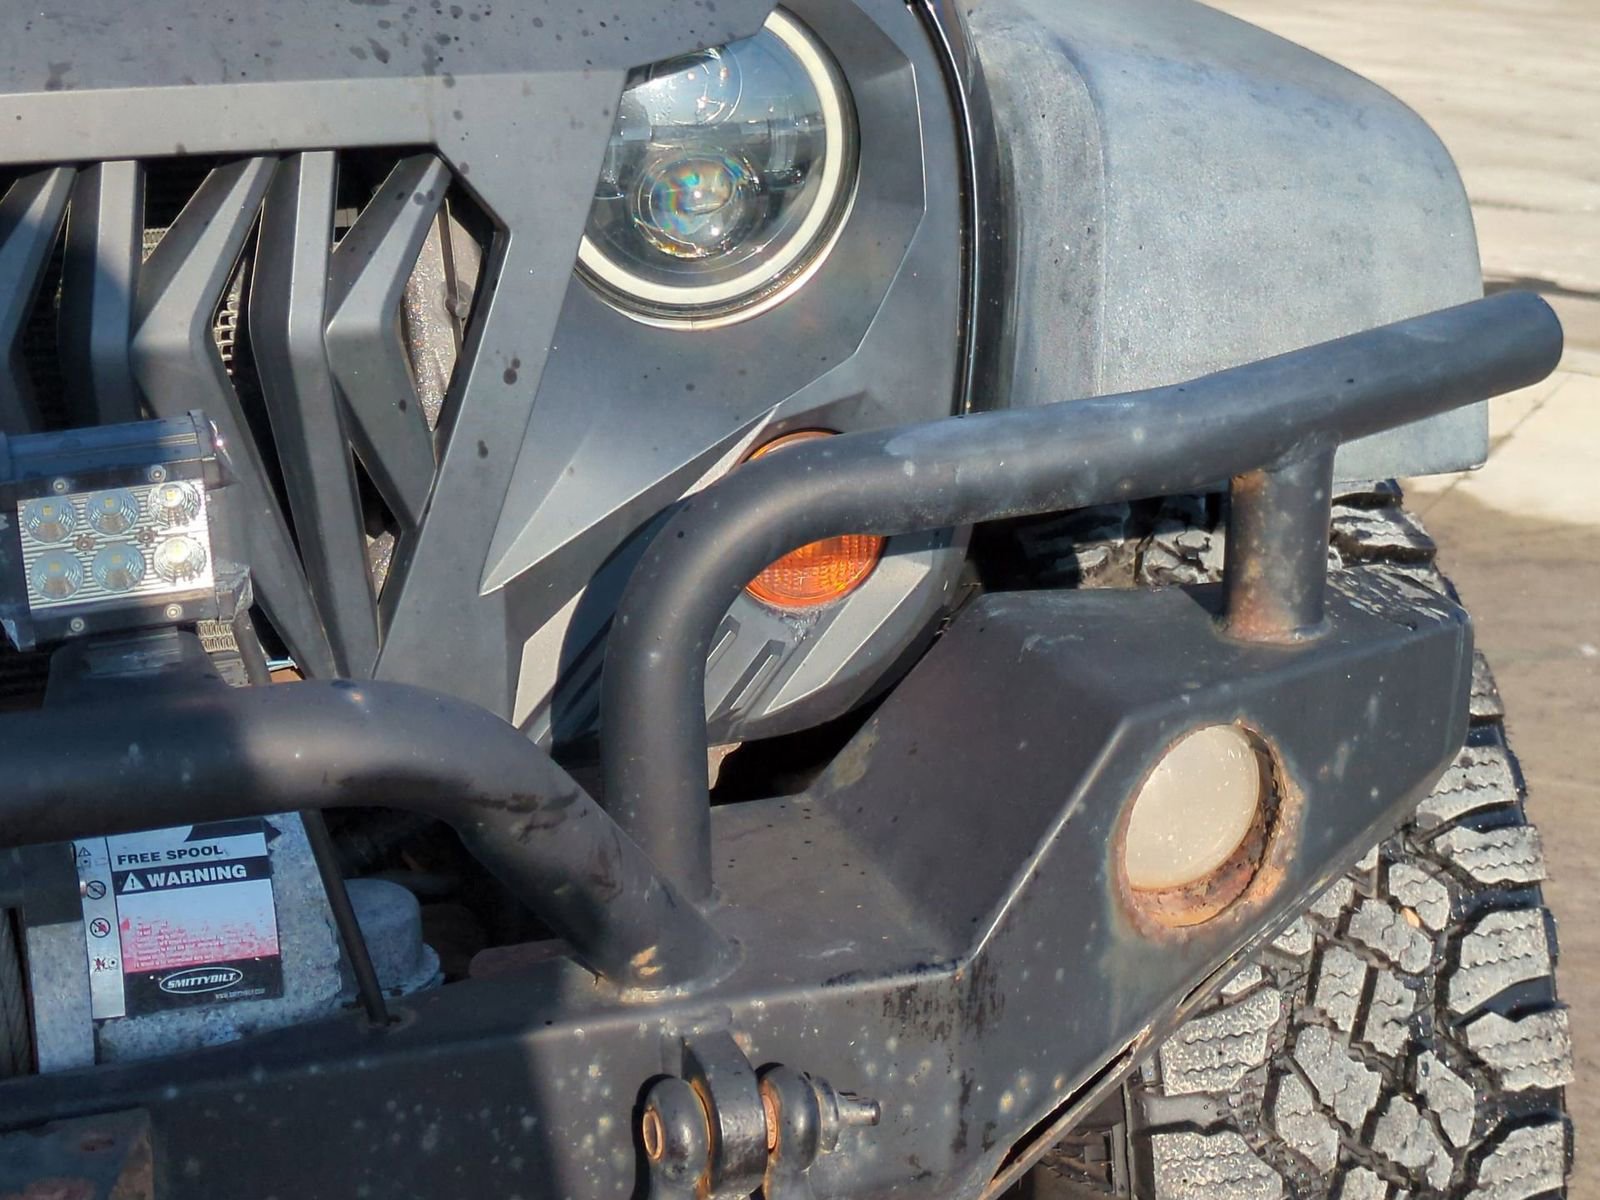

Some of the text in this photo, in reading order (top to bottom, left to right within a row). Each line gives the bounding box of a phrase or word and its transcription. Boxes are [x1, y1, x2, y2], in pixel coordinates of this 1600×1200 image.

[117, 845, 223, 866] FREE SPOOL
[146, 864, 247, 888] WARNING
[167, 973, 236, 990] SMITTYBILT
